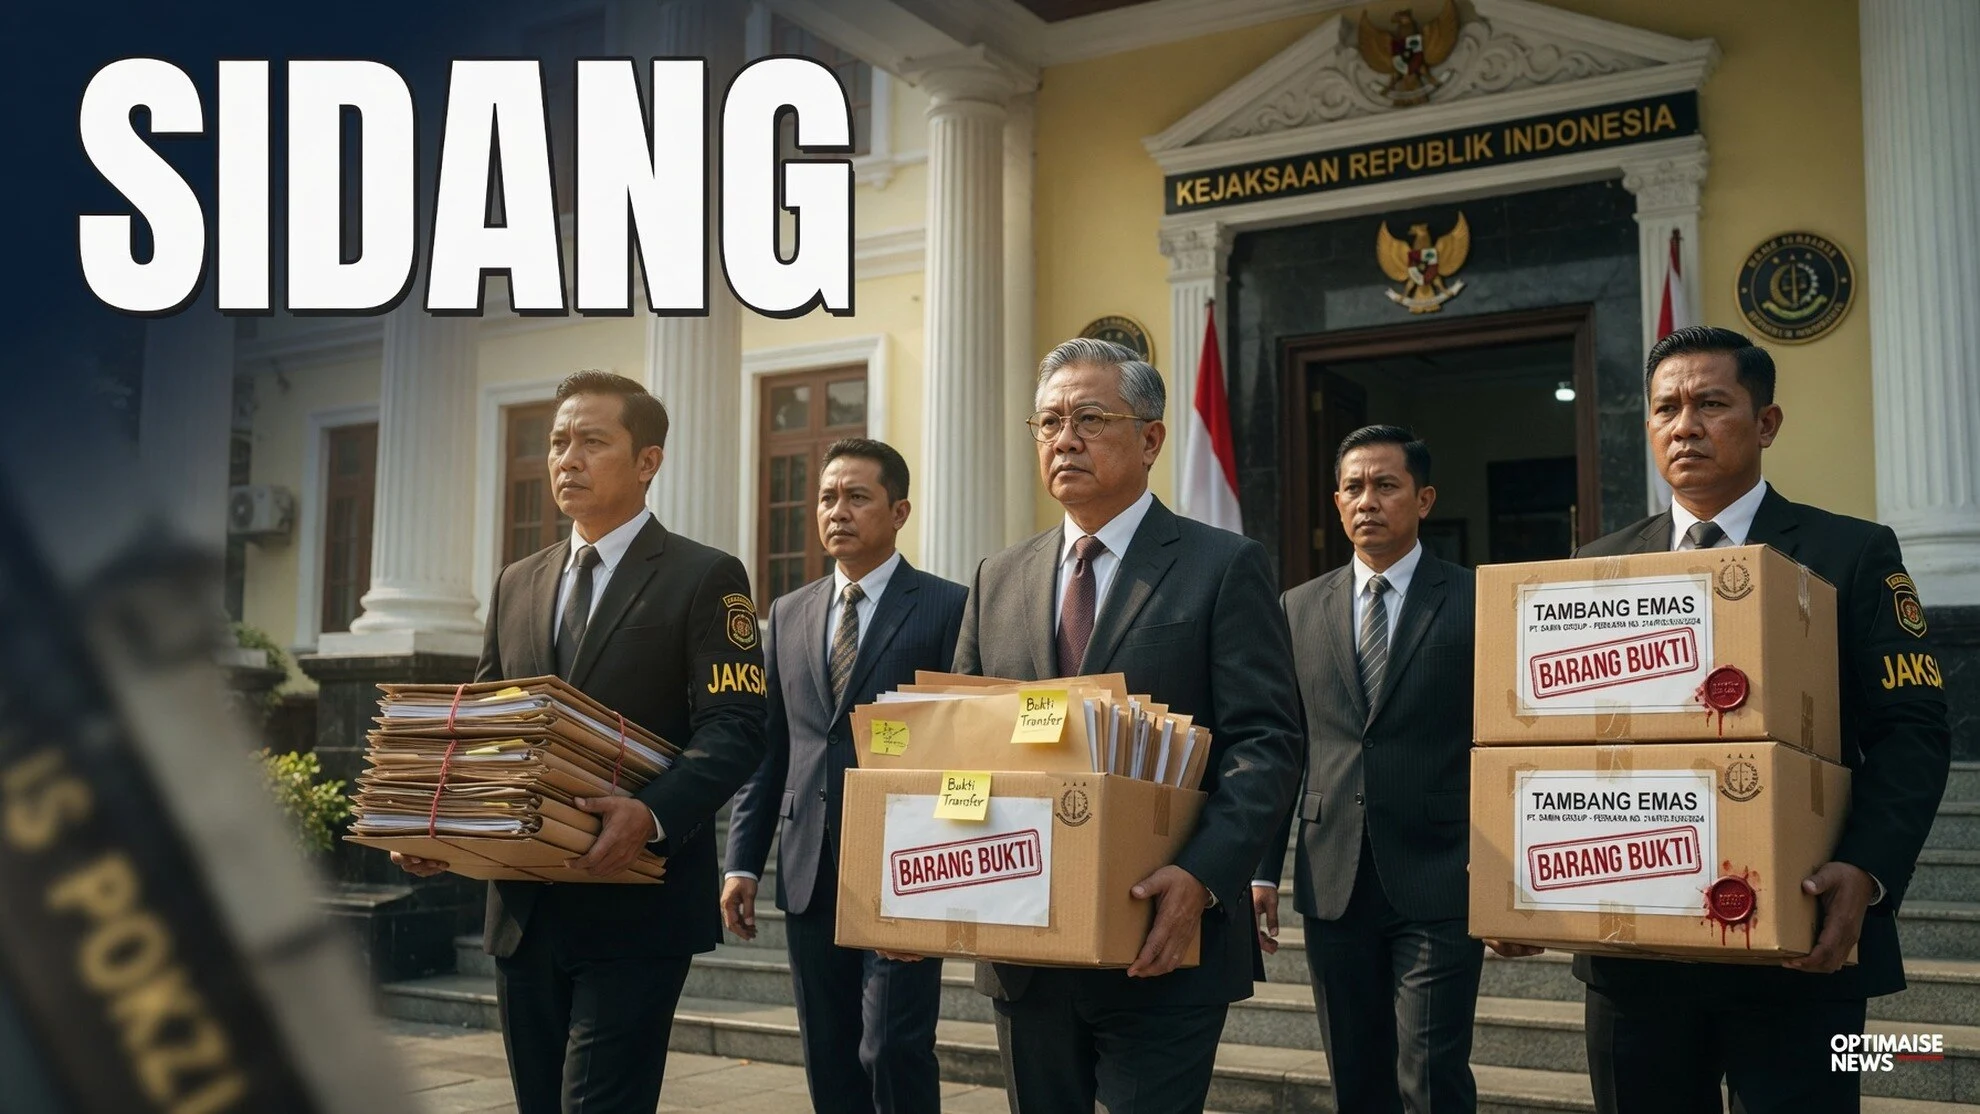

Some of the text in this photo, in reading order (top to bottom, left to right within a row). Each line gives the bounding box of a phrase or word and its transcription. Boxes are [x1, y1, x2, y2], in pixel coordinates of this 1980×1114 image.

[1176, 104, 1677, 206] KEJAKSAAN REPUBLIK INDONESIA
[1533, 596, 1695, 621] TAMBANG EMAS
[1539, 636, 1690, 690] BARANG BUKTI
[1532, 791, 1698, 811] TAMBANG EMAS
[899, 838, 1034, 886] BARANG BUKTI
[1537, 835, 1693, 882] BARANG BUKTI
